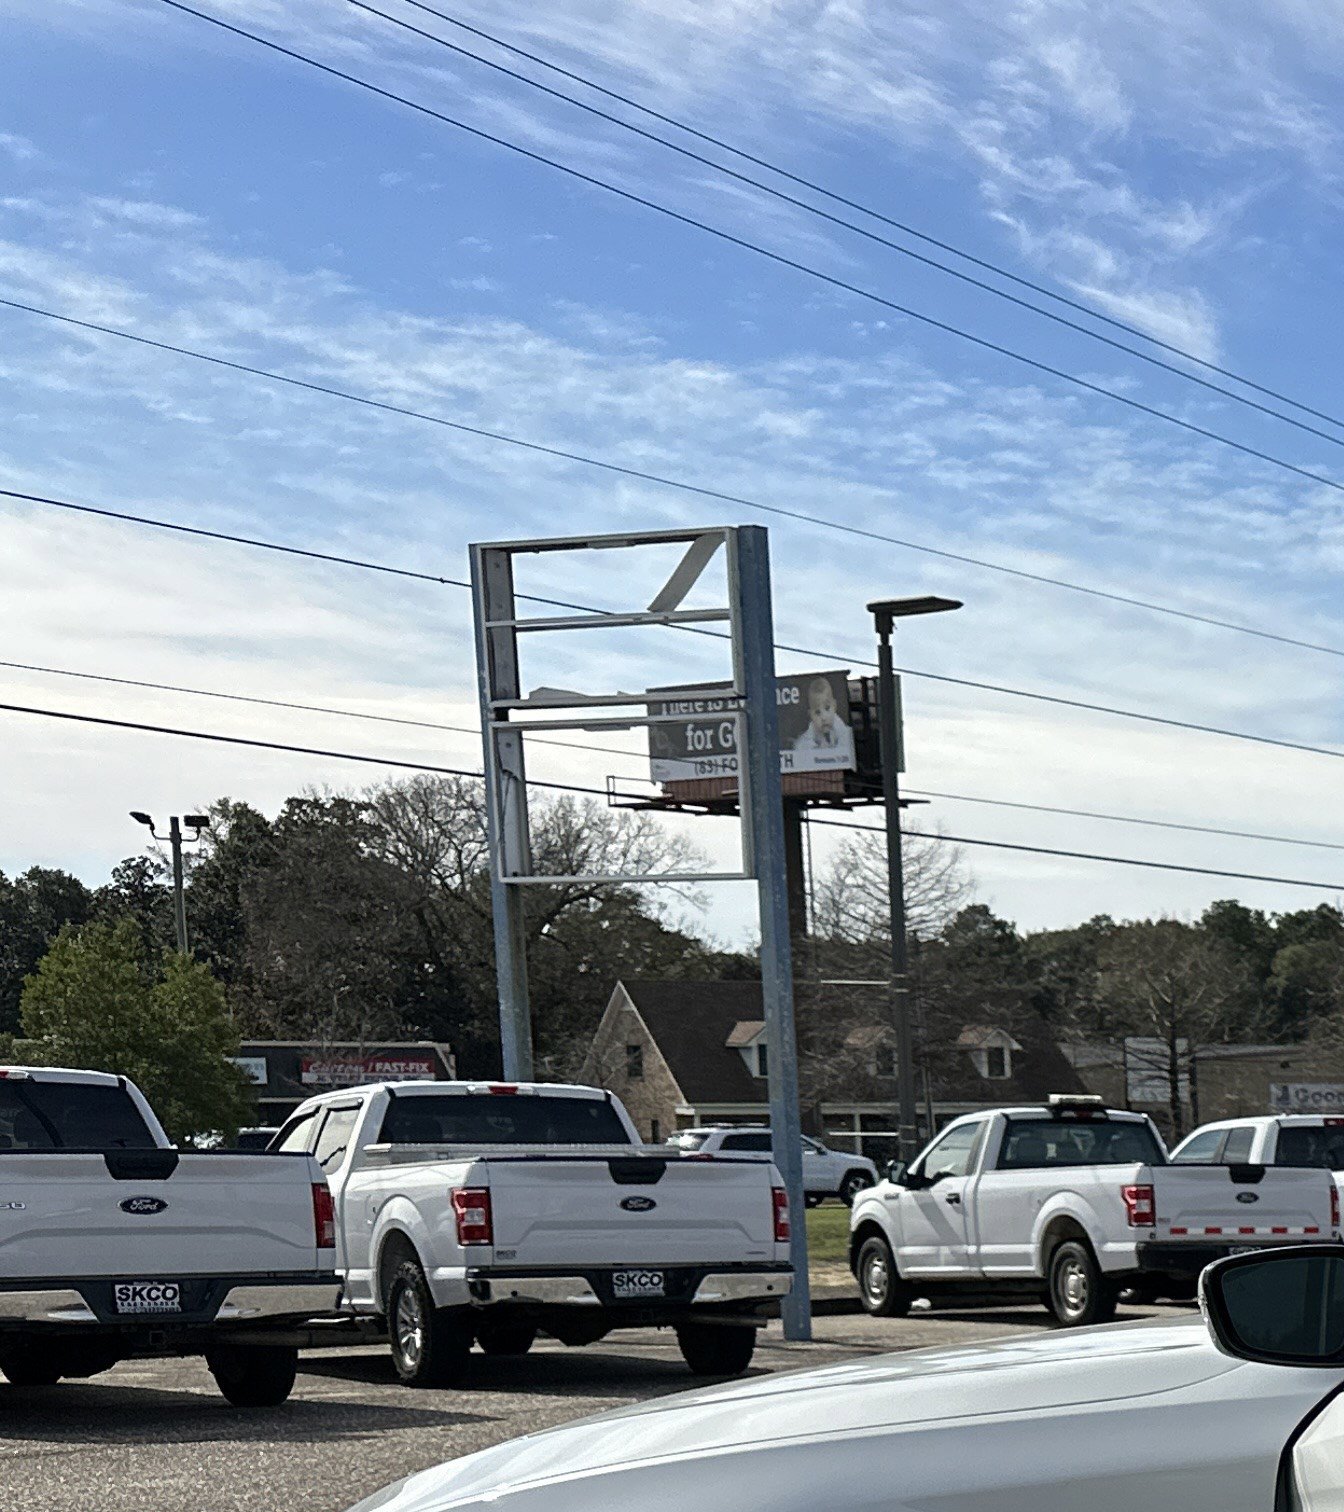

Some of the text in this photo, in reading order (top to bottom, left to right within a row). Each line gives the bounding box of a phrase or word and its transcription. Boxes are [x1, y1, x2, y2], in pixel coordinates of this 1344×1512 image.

[685, 723, 714, 751] for
[374, 1061, 429, 1073] FAST-FIX
[614, 1273, 663, 1288] SKCO
[117, 1286, 179, 1302] SKCO
